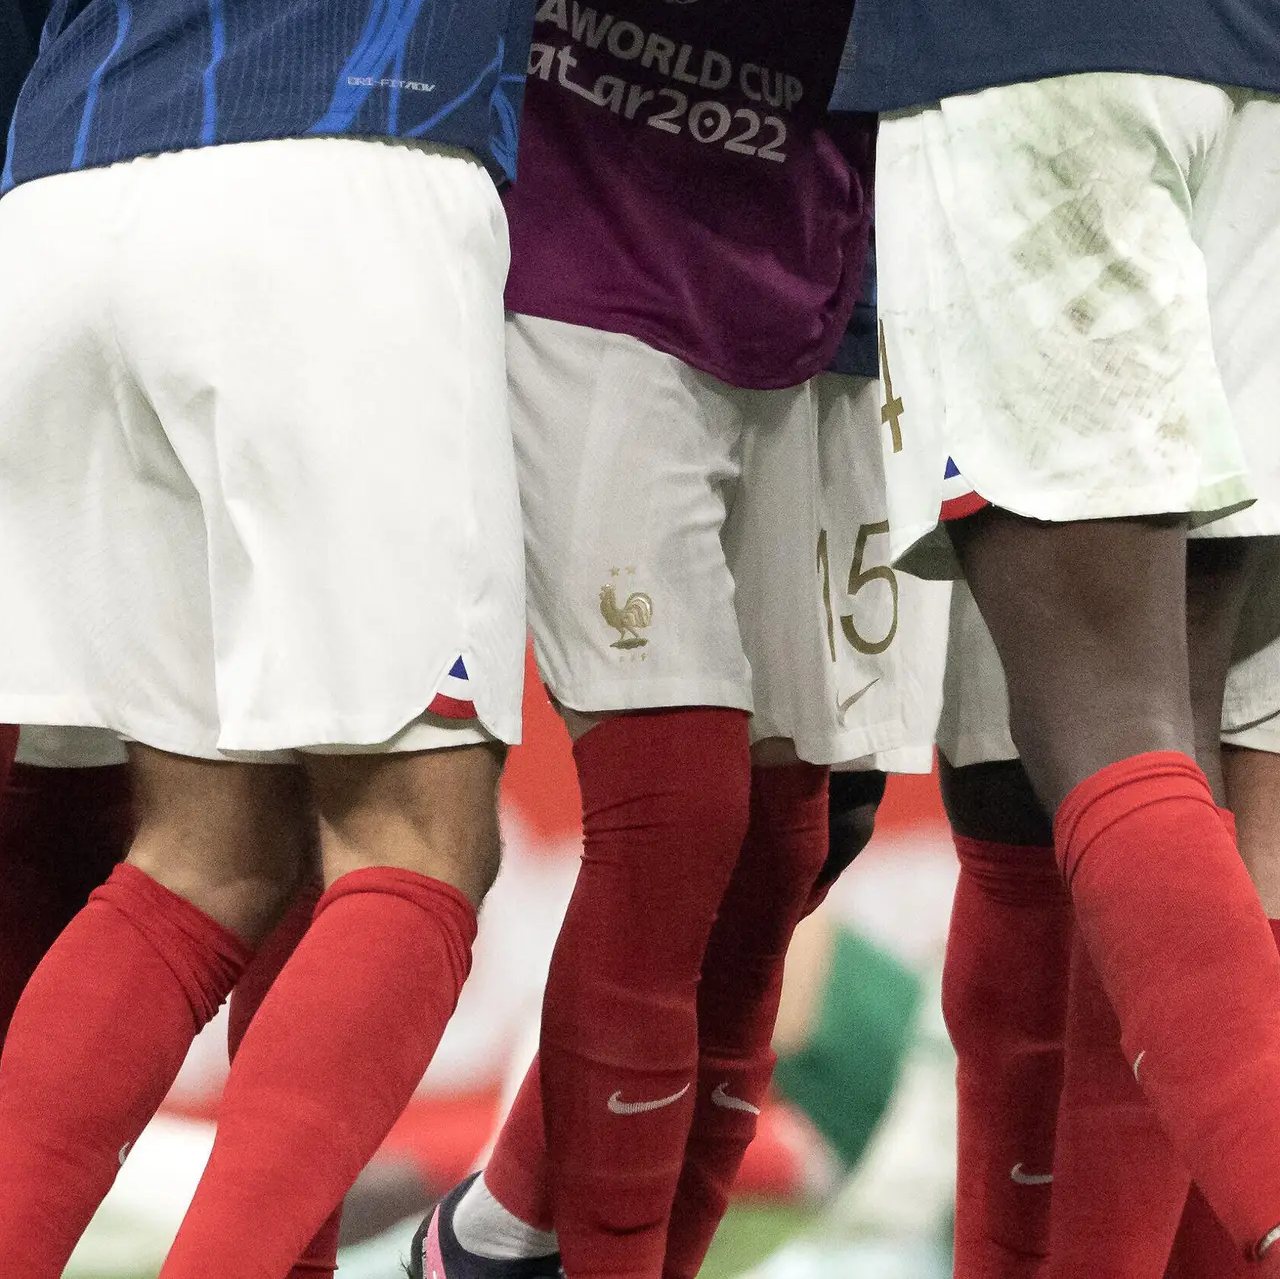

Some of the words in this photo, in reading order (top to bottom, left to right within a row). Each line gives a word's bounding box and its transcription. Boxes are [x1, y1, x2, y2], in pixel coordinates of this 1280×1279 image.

[571, 1, 732, 90] WORLD
[739, 62, 804, 111] CUP
[817, 520, 899, 662] 15
